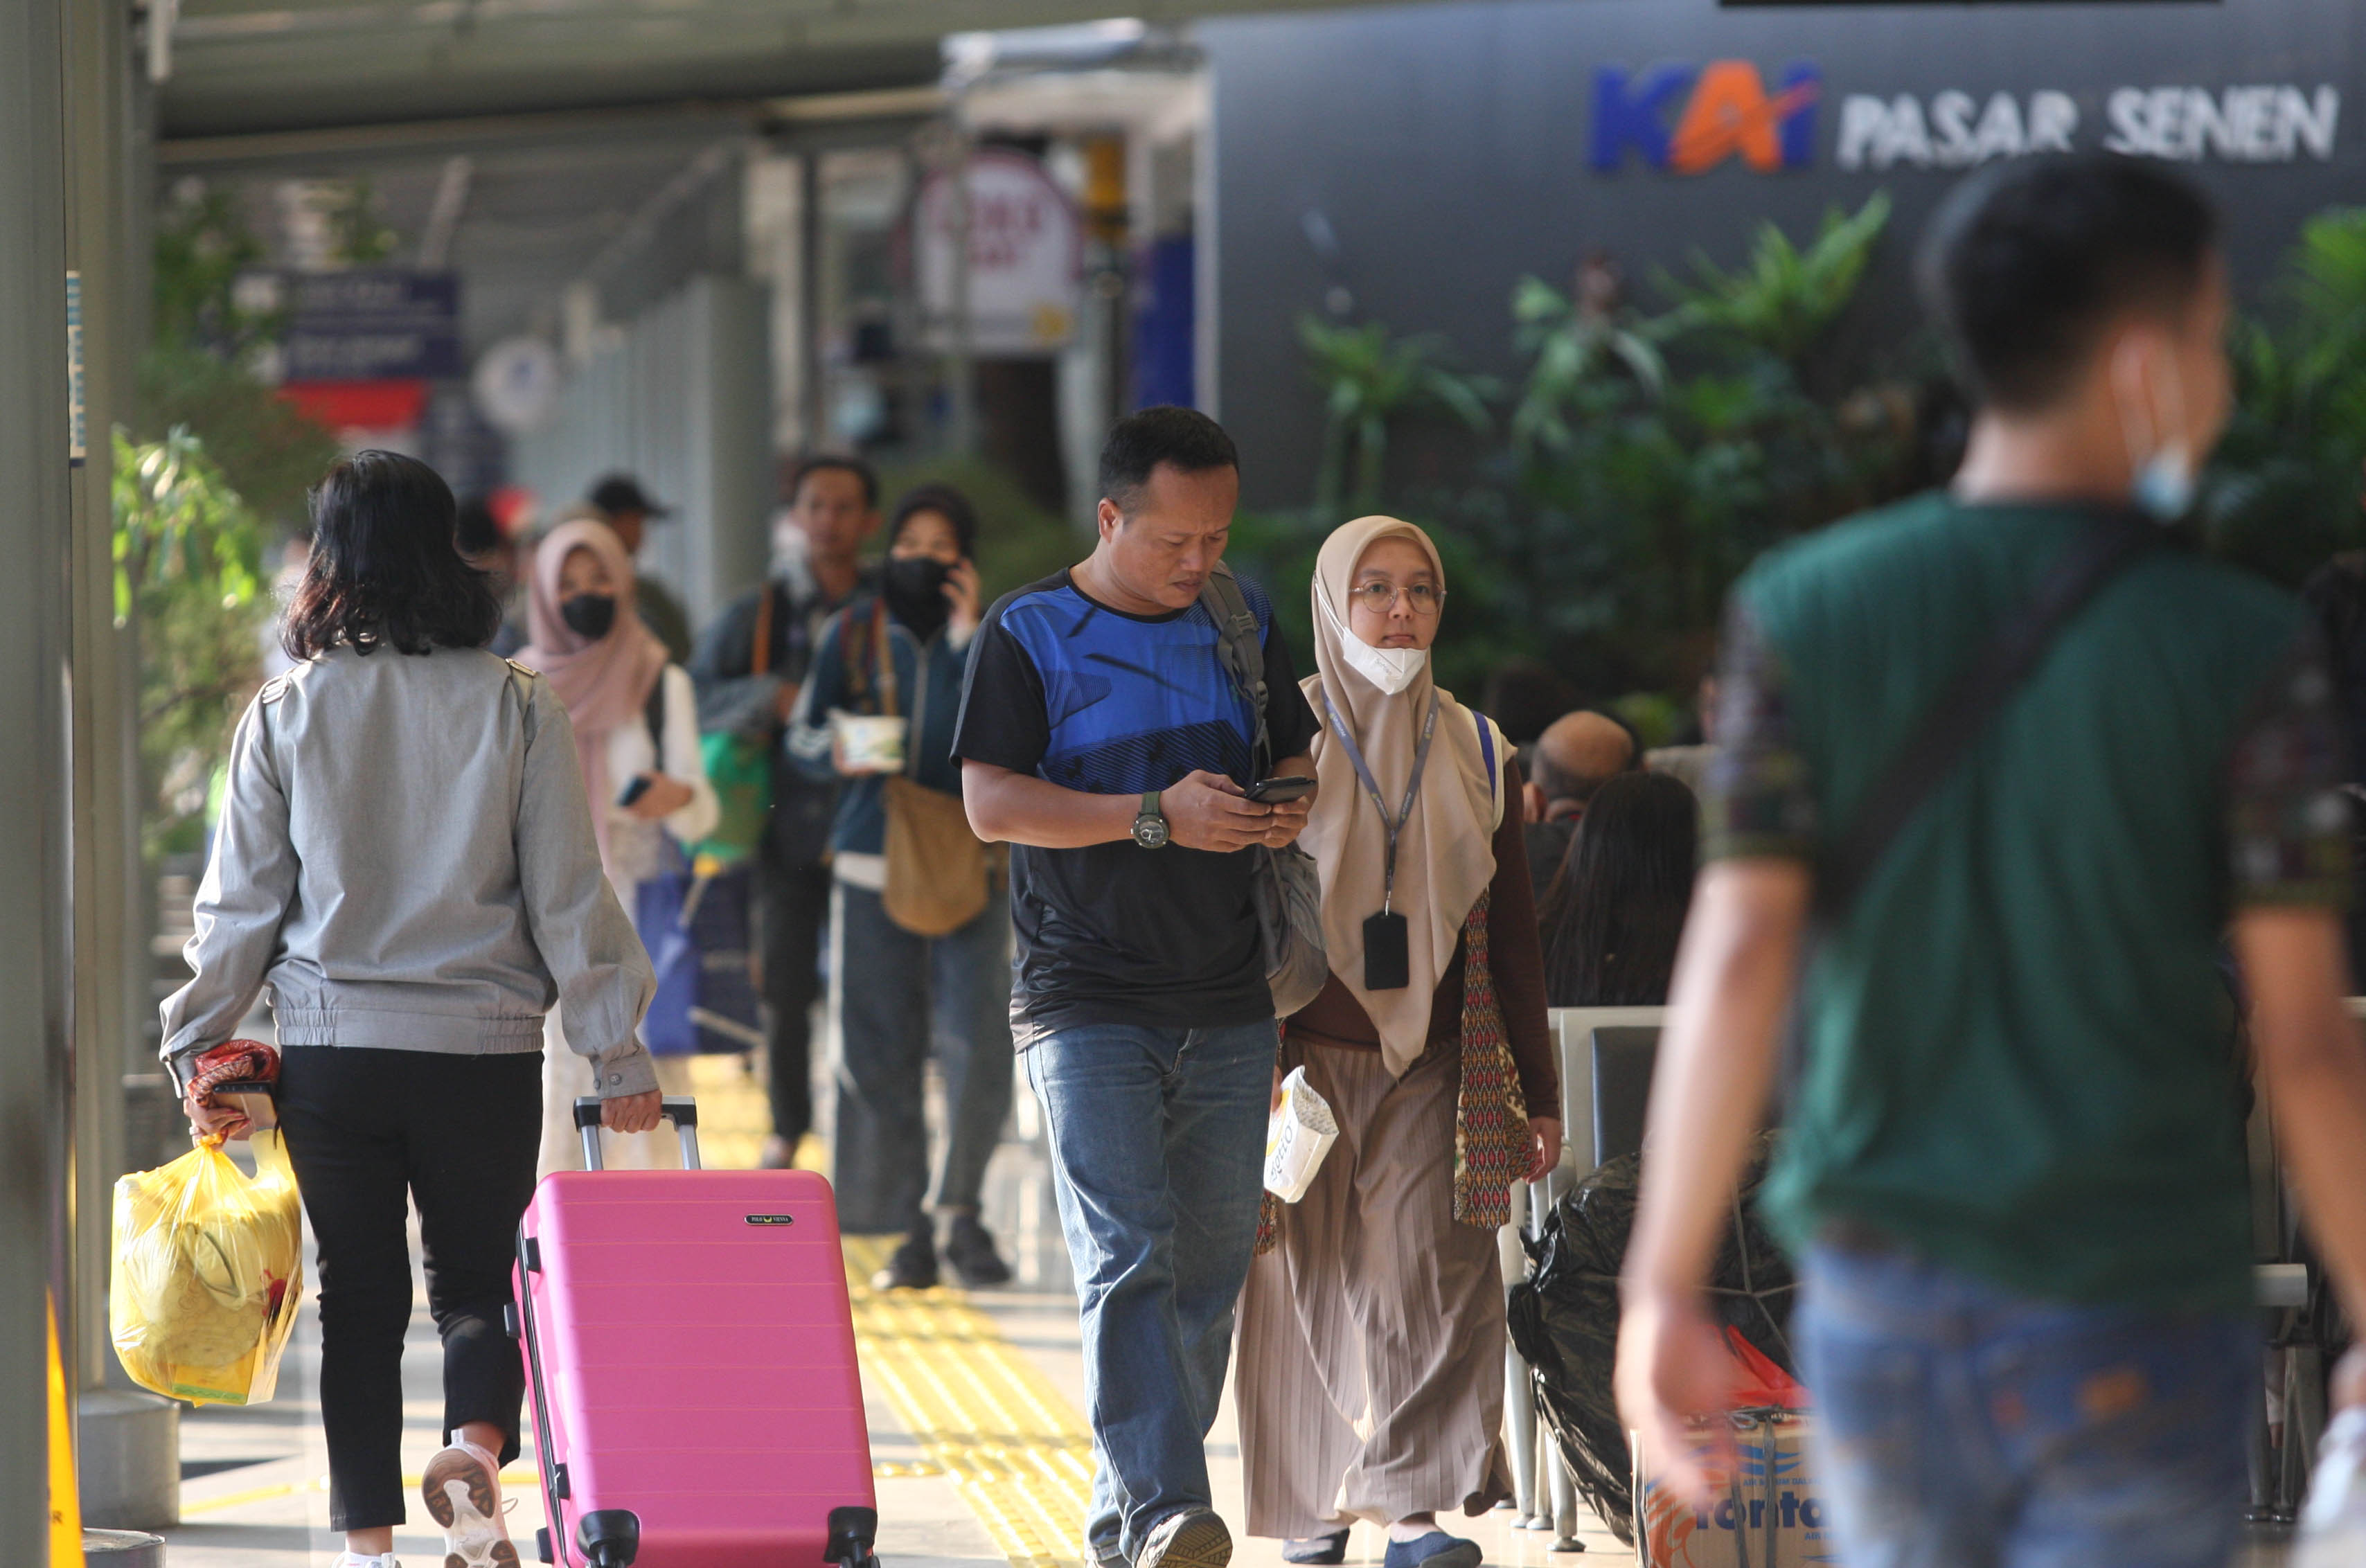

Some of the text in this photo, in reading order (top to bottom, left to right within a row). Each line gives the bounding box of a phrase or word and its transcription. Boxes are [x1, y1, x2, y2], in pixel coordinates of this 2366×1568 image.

[1591, 58, 2341, 172] KAI PASAR SENEN
